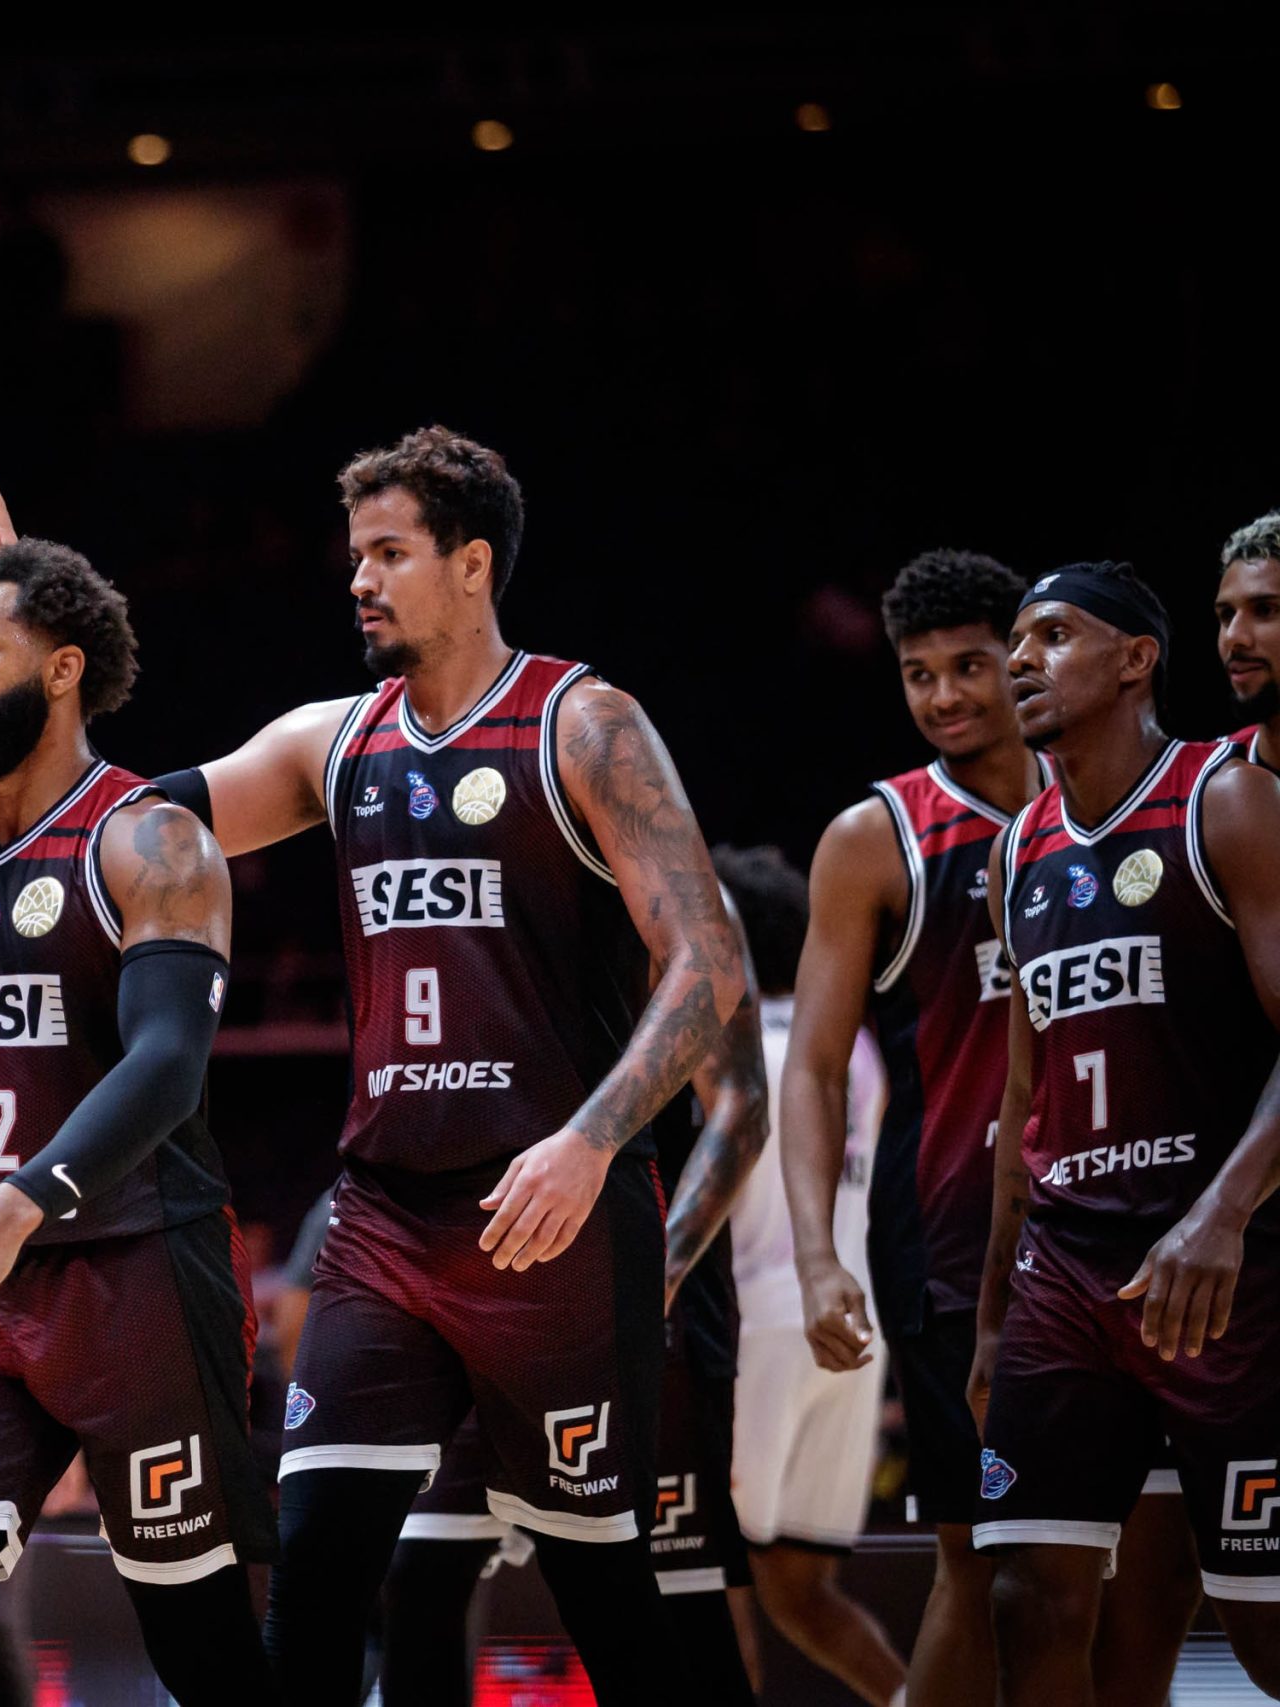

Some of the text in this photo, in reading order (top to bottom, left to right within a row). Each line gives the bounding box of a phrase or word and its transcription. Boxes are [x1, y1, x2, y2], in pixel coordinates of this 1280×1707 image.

[354, 801, 385, 818] Topper
[371, 867, 484, 927] SESI
[1030, 946, 1143, 1018] SESI
[405, 966, 443, 1046] 9
[1072, 1049, 1109, 1132] 7
[548, 1474, 620, 1498] FREEWAY
[132, 1511, 214, 1540] FREEWAY
[1220, 1536, 1280, 1552] FREEW
